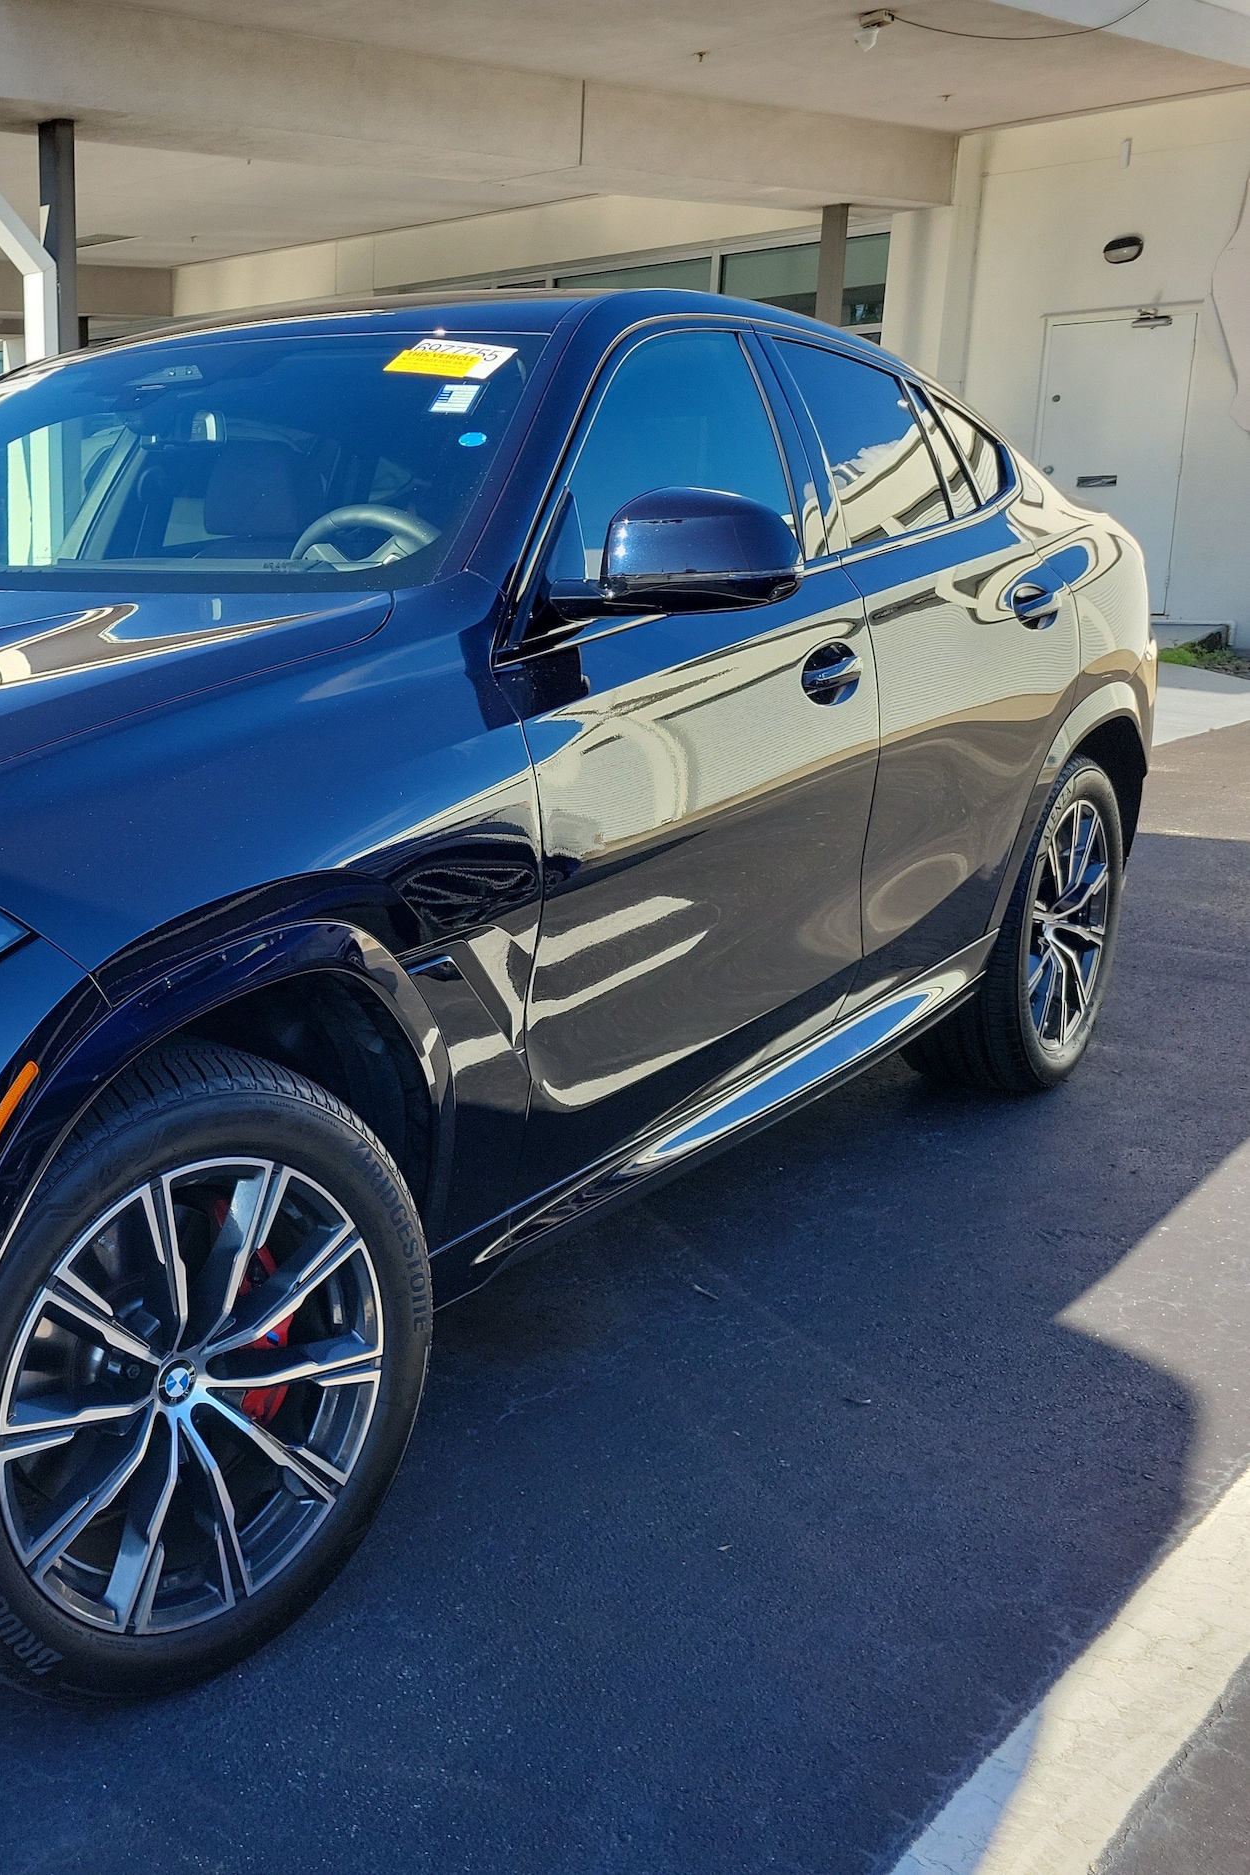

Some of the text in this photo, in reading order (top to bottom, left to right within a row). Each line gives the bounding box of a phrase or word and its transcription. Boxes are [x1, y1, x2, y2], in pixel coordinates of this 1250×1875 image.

[414, 342, 502, 362] 6977755
[432, 352, 479, 362] VEHICLE
[1043, 786, 1072, 846] ALENZA
[352, 1141, 428, 1333] BRIDGESTONE
